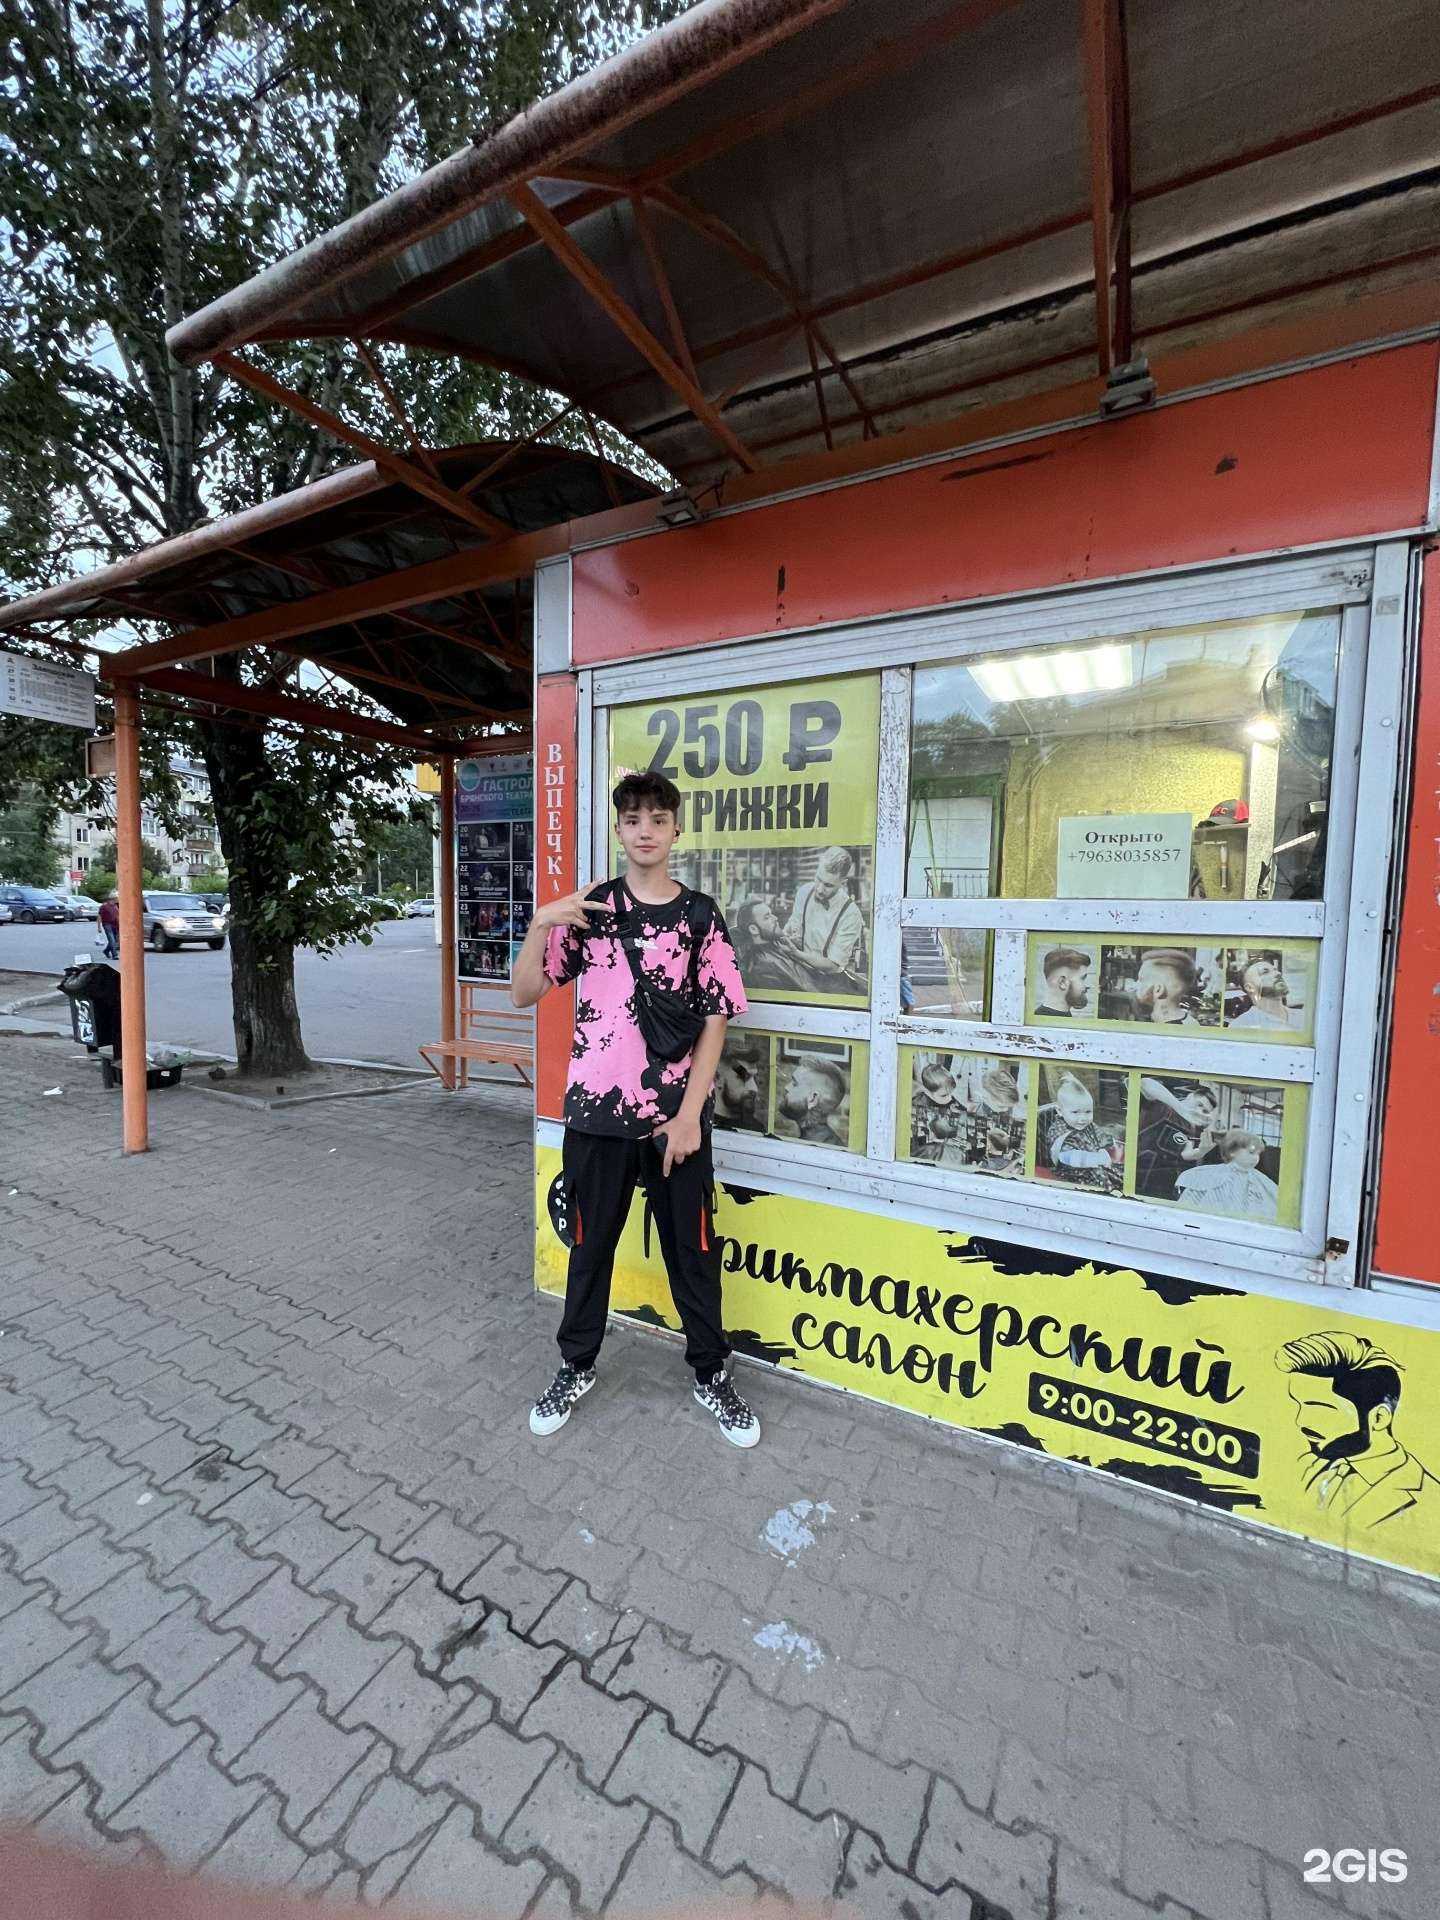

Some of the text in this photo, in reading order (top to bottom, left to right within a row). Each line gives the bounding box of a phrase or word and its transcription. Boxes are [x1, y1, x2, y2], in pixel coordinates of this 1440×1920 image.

[647, 699, 764, 780] 250
[676, 782, 830, 834] ТРИЖКИ
[1085, 830, 1164, 846] Открыто
[1067, 848, 1182, 864] +79638035857
[642, 1190, 1246, 1404] рикмахерский
[791, 1311, 987, 1399] салон
[1038, 1383, 1243, 1465] 9:00-22:00
